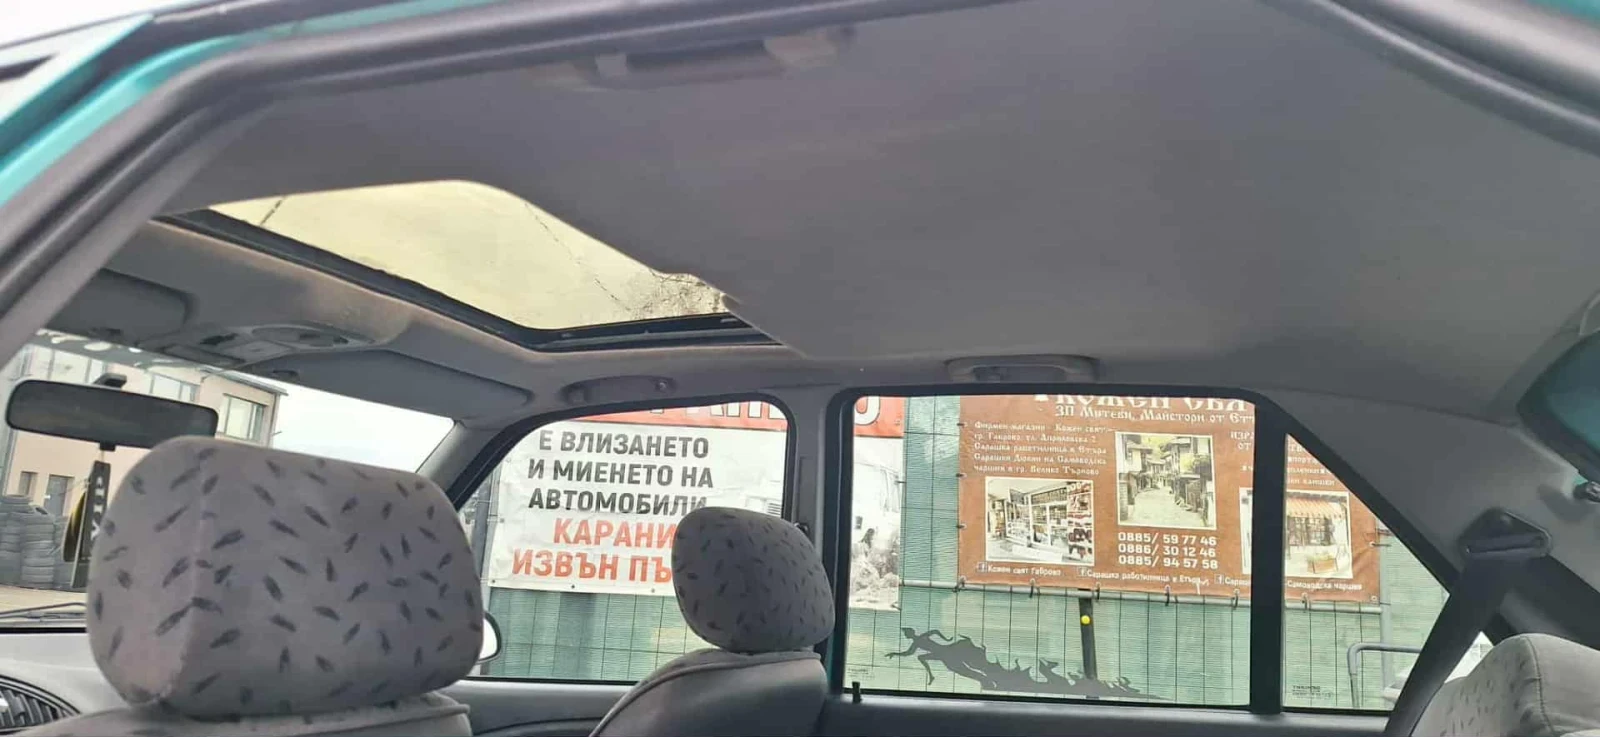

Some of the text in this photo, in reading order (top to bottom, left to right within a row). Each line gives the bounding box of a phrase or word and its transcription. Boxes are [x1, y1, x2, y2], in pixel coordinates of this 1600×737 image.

[1055, 404, 1075, 417] ЗП
[539, 430, 710, 458] Е ВЛИЗАНЕТО
[528, 458, 713, 488] И МИЕНЕТО НА
[553, 518, 677, 548] КАРАНИ
[1118, 532, 1217, 546] 0885/ 59 77 46
[1118, 543, 1216, 557] 0886/ 30 12 46
[512, 549, 620, 580] ИЗВЪН
[1118, 555, 1218, 569] 0885/ 94 57 58
